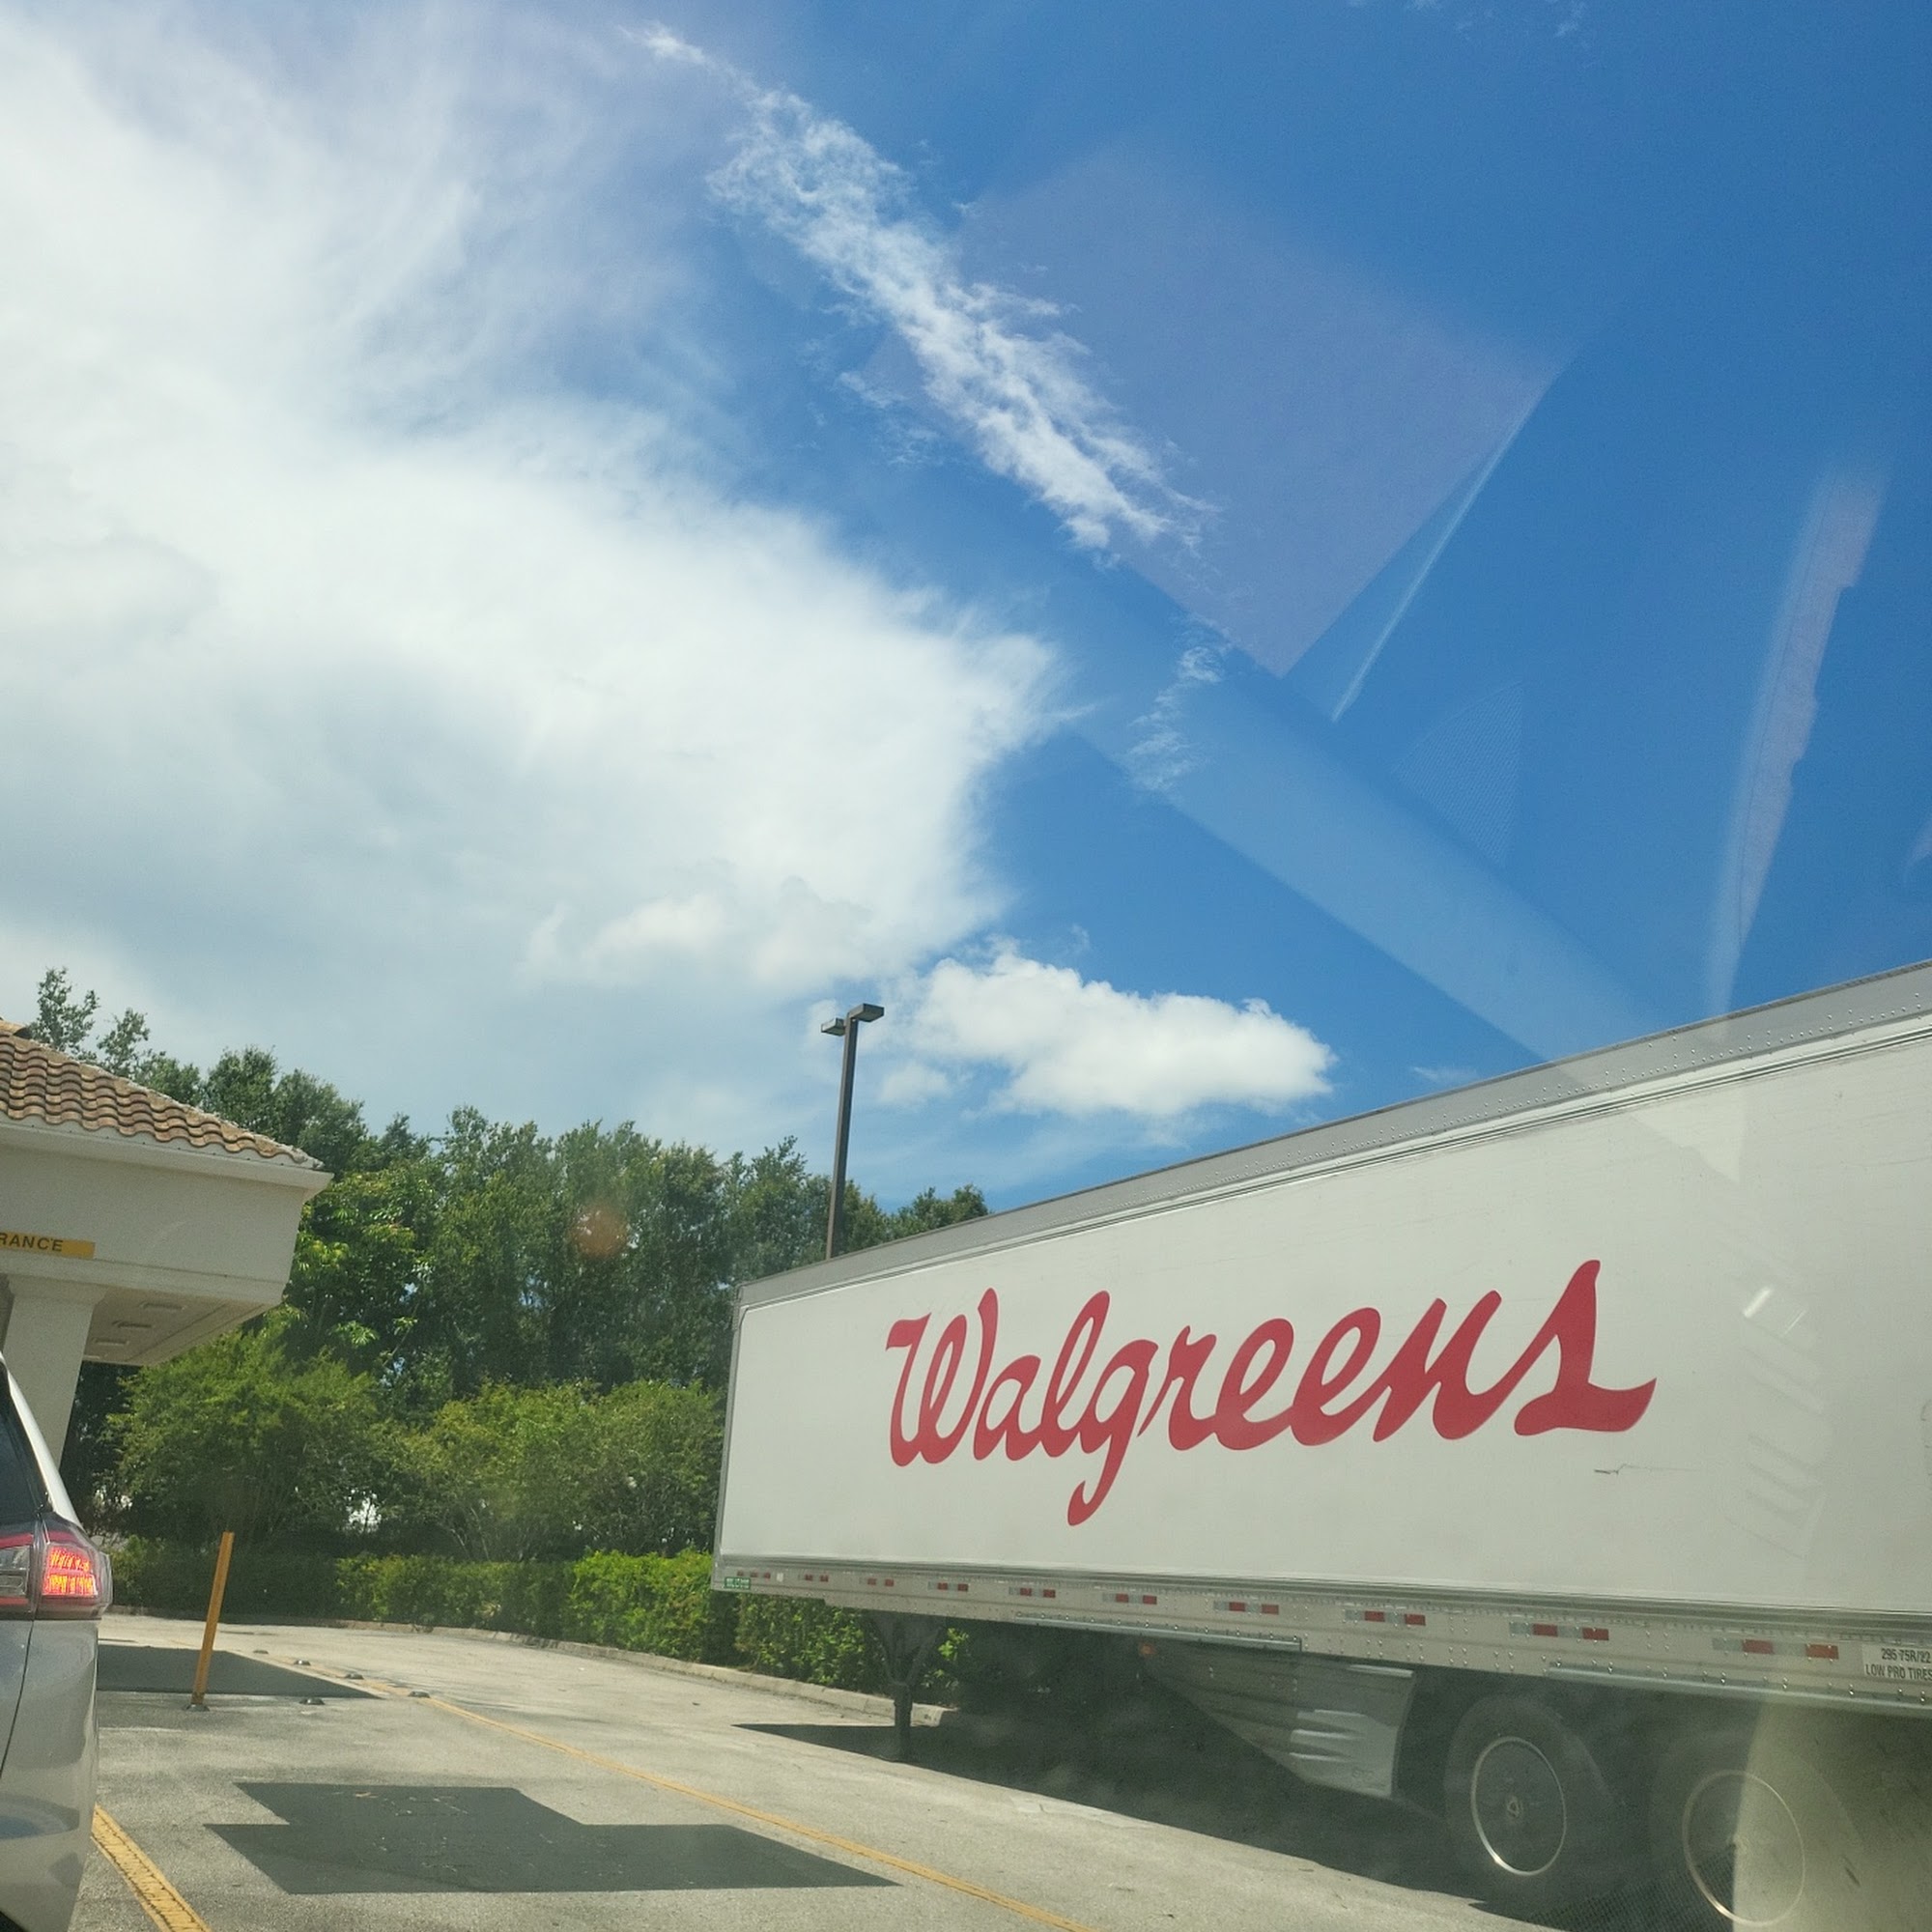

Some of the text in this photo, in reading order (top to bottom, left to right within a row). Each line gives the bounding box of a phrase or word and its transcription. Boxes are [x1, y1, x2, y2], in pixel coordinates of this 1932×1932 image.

[886, 1259, 1657, 1526] Walgreens
[1865, 1663, 1932, 1681] LOW PRO TIRES
